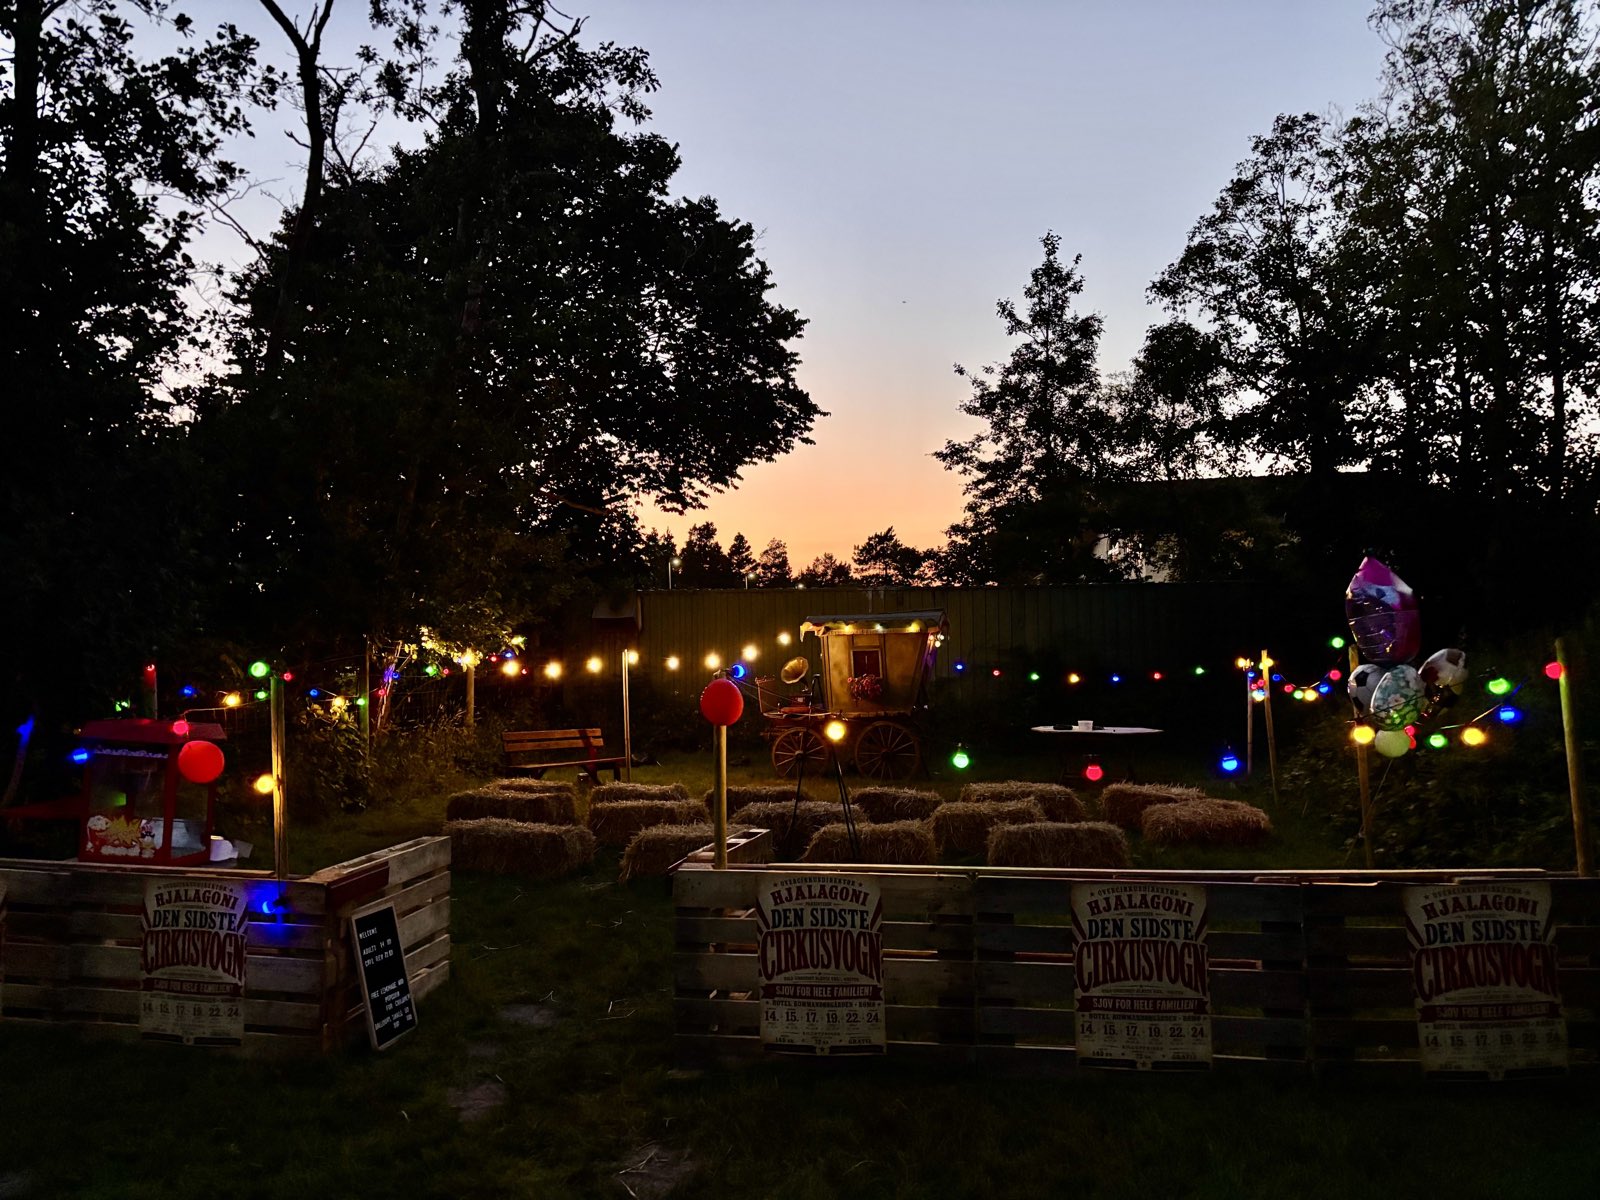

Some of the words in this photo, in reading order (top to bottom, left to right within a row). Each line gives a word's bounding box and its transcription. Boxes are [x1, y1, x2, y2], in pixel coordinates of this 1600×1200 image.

[155, 889, 240, 910] HJALAGONI
[770, 884, 870, 906] HJALAGONI
[1086, 893, 1194, 917] HJALAGONI
[771, 908, 804, 929] DEN
[810, 908, 869, 929] SIDSTE
[1421, 894, 1539, 921] HJALAGONI
[153, 909, 180, 928] DEN
[184, 910, 237, 932] SIDSTE
[1087, 918, 1124, 940] DEN
[1130, 918, 1194, 940] SIDSTE
[1424, 920, 1465, 946] DEN
[1472, 919, 1542, 942] SIDSTE
[143, 929, 244, 980] CIRKUSVOGN
[761, 928, 881, 983] CIRKUSVOGN
[1077, 939, 1207, 997] CIRKUSVOGN
[1415, 943, 1558, 1001] CIRKUSVOGN
[776, 985, 795, 996] SJOV
[796, 985, 811, 997] FOR
[813, 986, 833, 998] HELE
[834, 986, 873, 998] FAMILIEN!
[1093, 998, 1114, 1009] SJOV
[1115, 999, 1132, 1009] FOR
[1134, 1000, 1154, 1010] HELE
[1157, 999, 1198, 1010] FAMILIEN!
[765, 1010, 779, 1022] 14.
[785, 1011, 799, 1022] 15.
